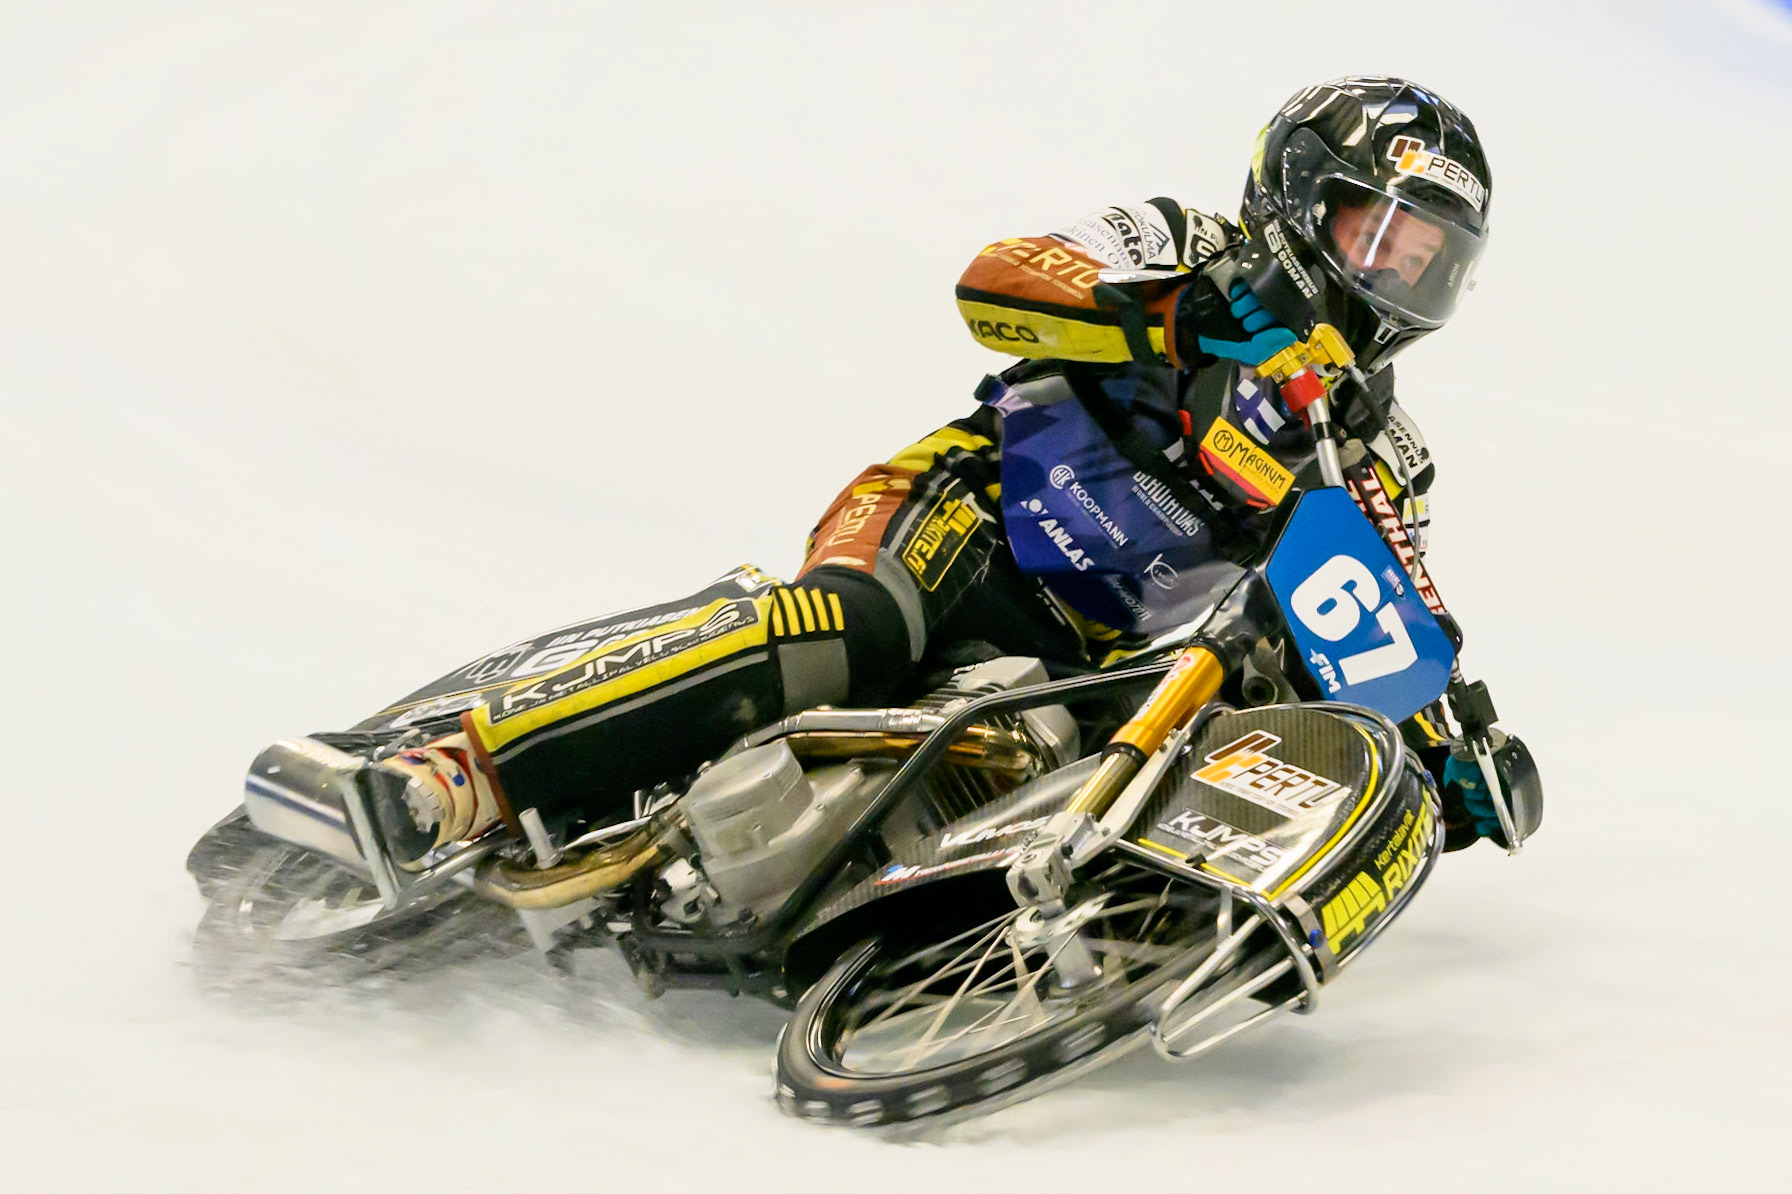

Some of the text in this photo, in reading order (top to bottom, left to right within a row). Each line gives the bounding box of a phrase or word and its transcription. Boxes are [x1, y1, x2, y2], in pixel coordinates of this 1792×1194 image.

[1427, 156, 1484, 203] PERTU
[1229, 438, 1288, 490] MAGNUM
[1069, 480, 1128, 548] KOOPMANN
[1038, 517, 1095, 572] ANLAS
[1290, 554, 1418, 686] 67
[1308, 648, 1342, 694] FIM
[1231, 758, 1346, 809] PERTU
[1168, 810, 1283, 868] KJMPS
